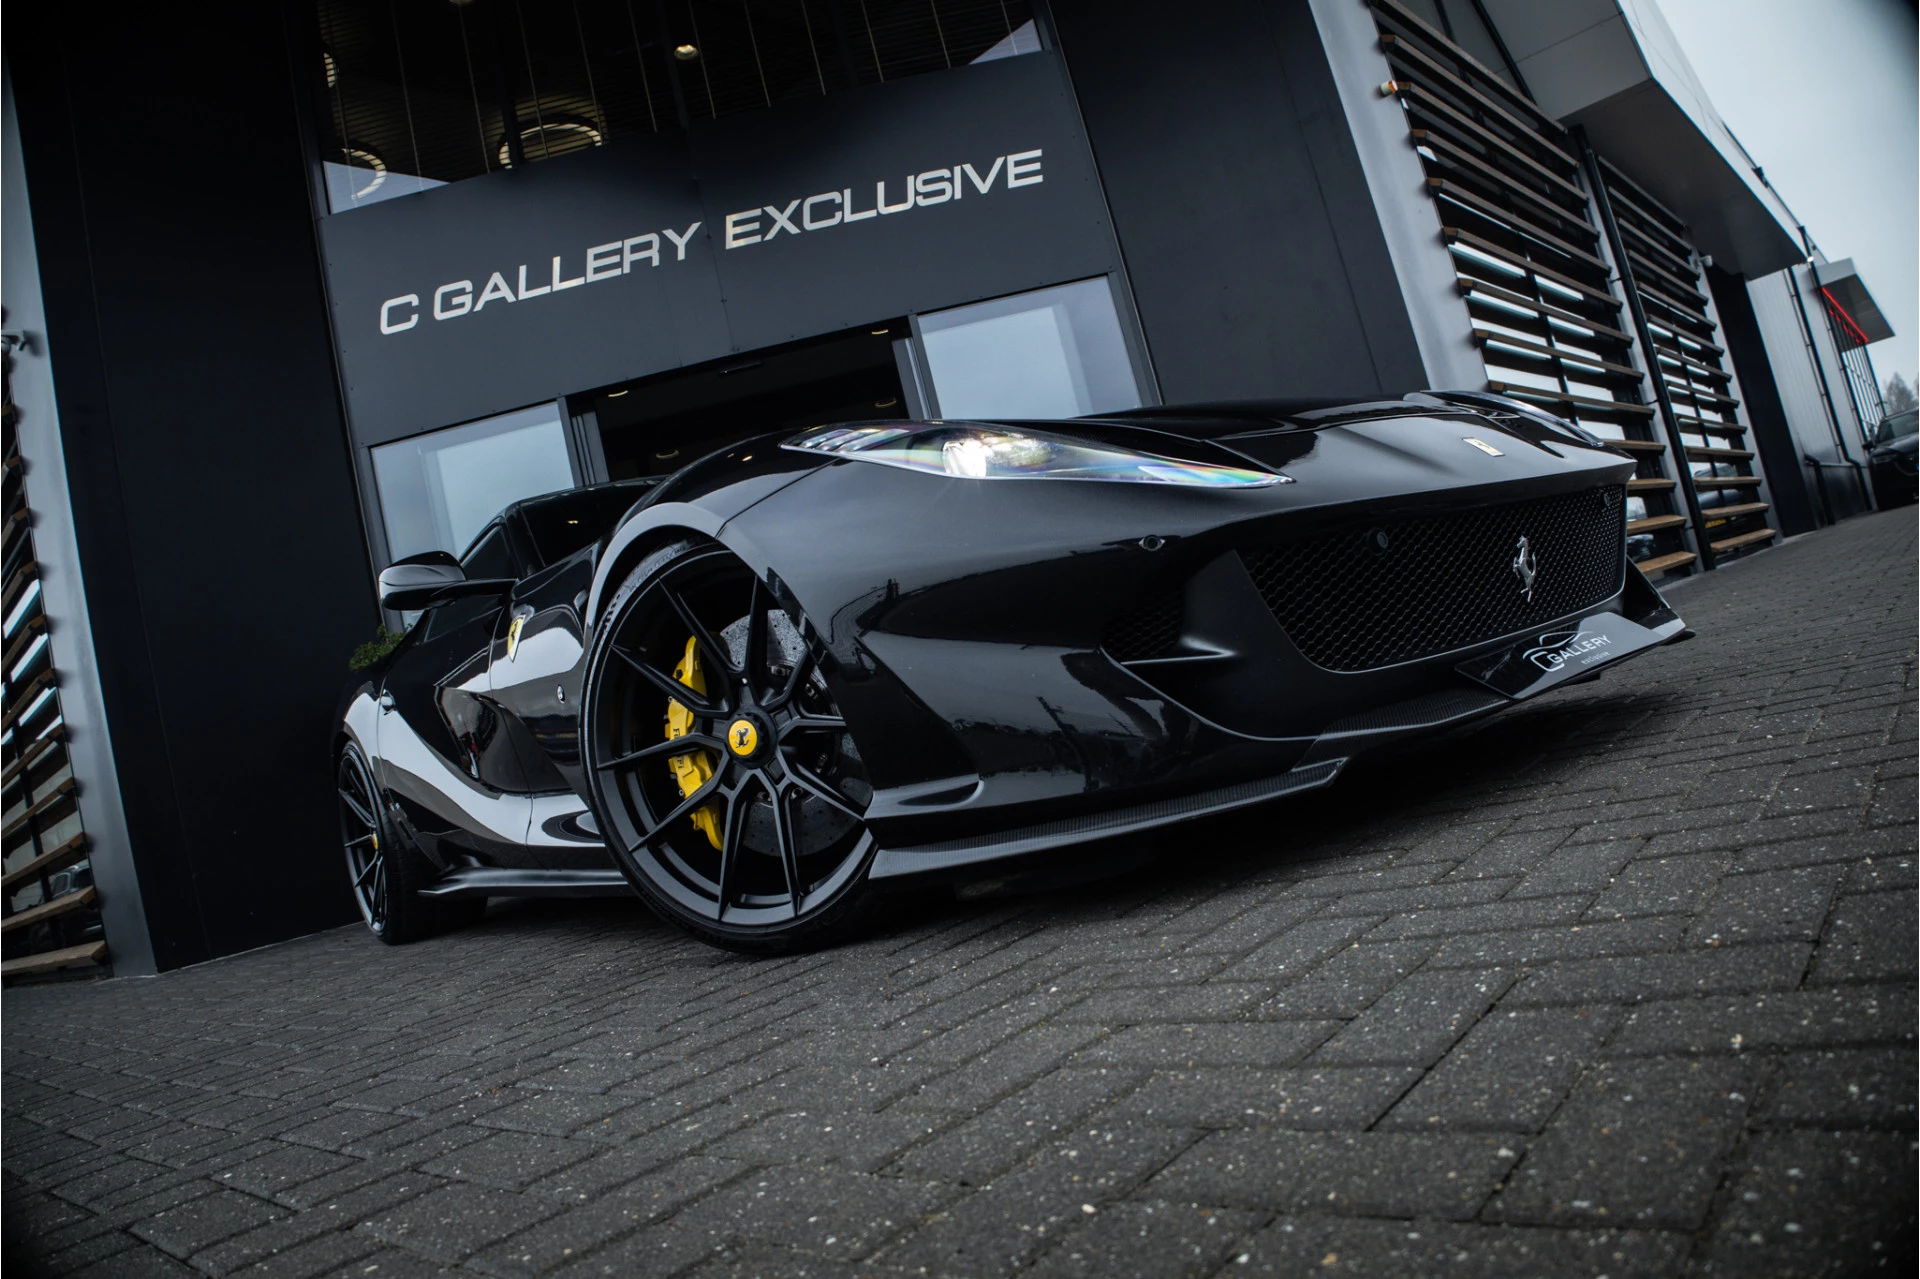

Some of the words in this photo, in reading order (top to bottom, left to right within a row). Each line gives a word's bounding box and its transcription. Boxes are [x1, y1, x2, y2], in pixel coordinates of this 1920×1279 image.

[379, 293, 419, 335] C
[433, 222, 702, 322] GALLERY
[725, 149, 1044, 250] EXCLUSIVE
